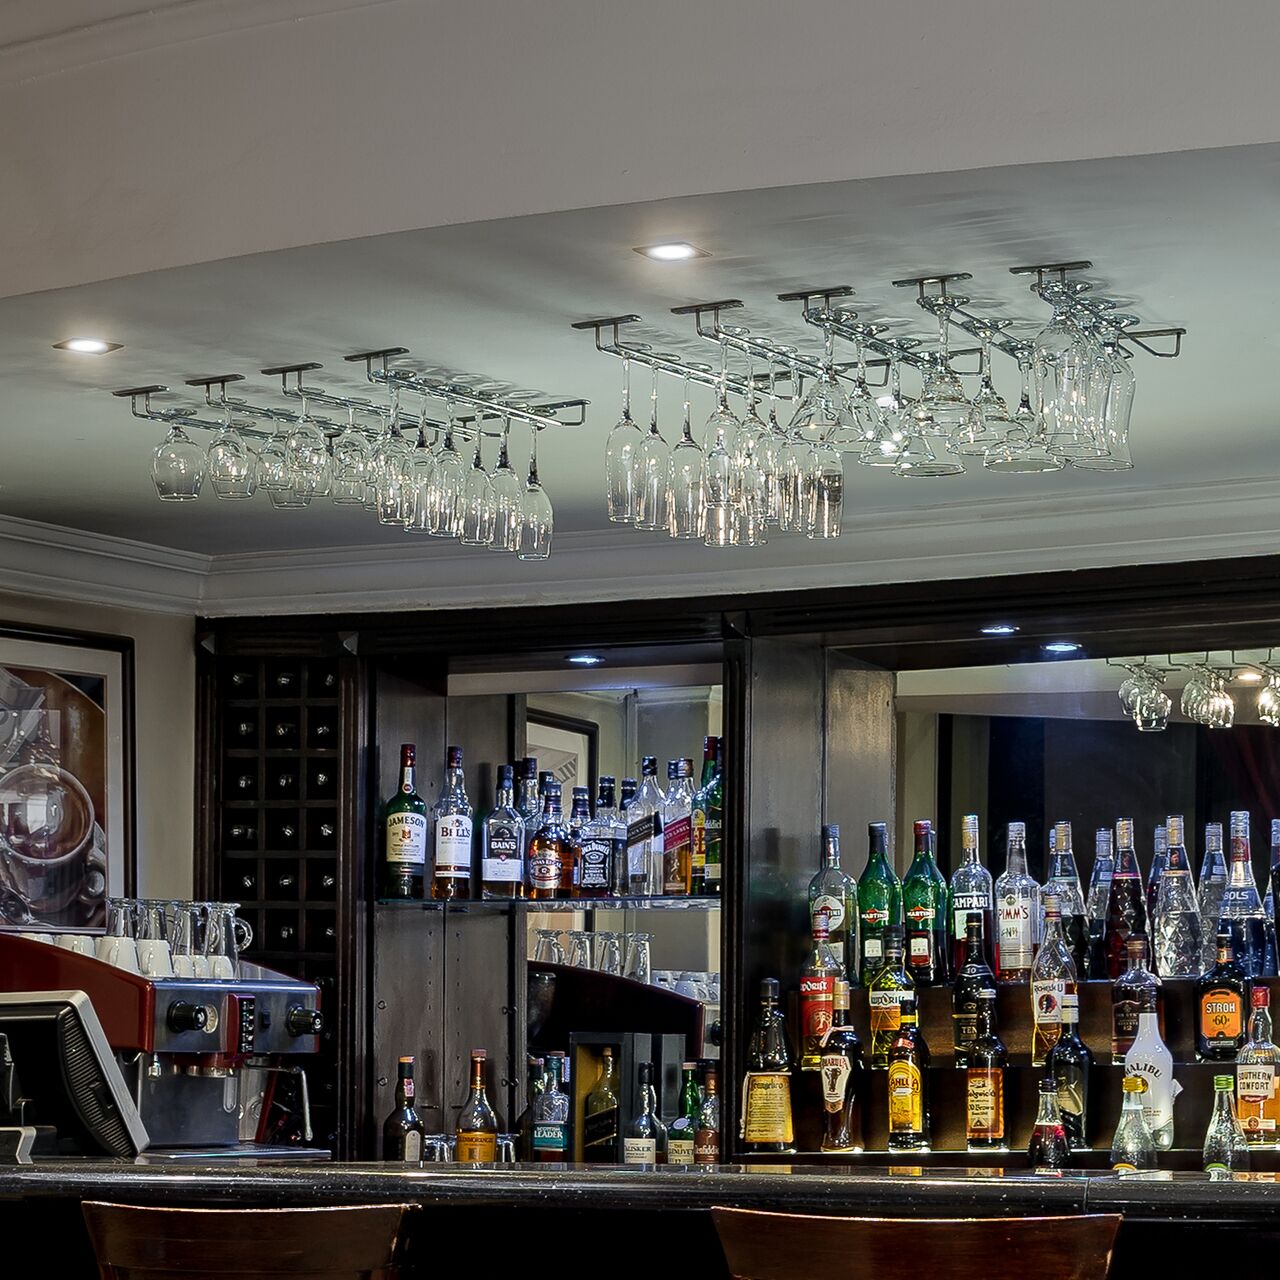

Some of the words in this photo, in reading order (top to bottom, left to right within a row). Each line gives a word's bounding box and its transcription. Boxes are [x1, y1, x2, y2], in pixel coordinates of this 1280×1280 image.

[388, 815, 425, 828] JAMESON
[440, 826, 471, 838] BELL'S
[491, 841, 517, 850] BAIN'S
[953, 896, 989, 909] AMPARI
[998, 905, 1029, 920] PIMM'S
[1206, 1002, 1236, 1014] STROH
[1213, 1014, 1228, 1026] 60
[1125, 1062, 1163, 1079] MALIBU
[1238, 1071, 1272, 1081] SOUTHERN
[1239, 1080, 1270, 1091] COMFORT
[533, 1130, 564, 1139] LEADER
